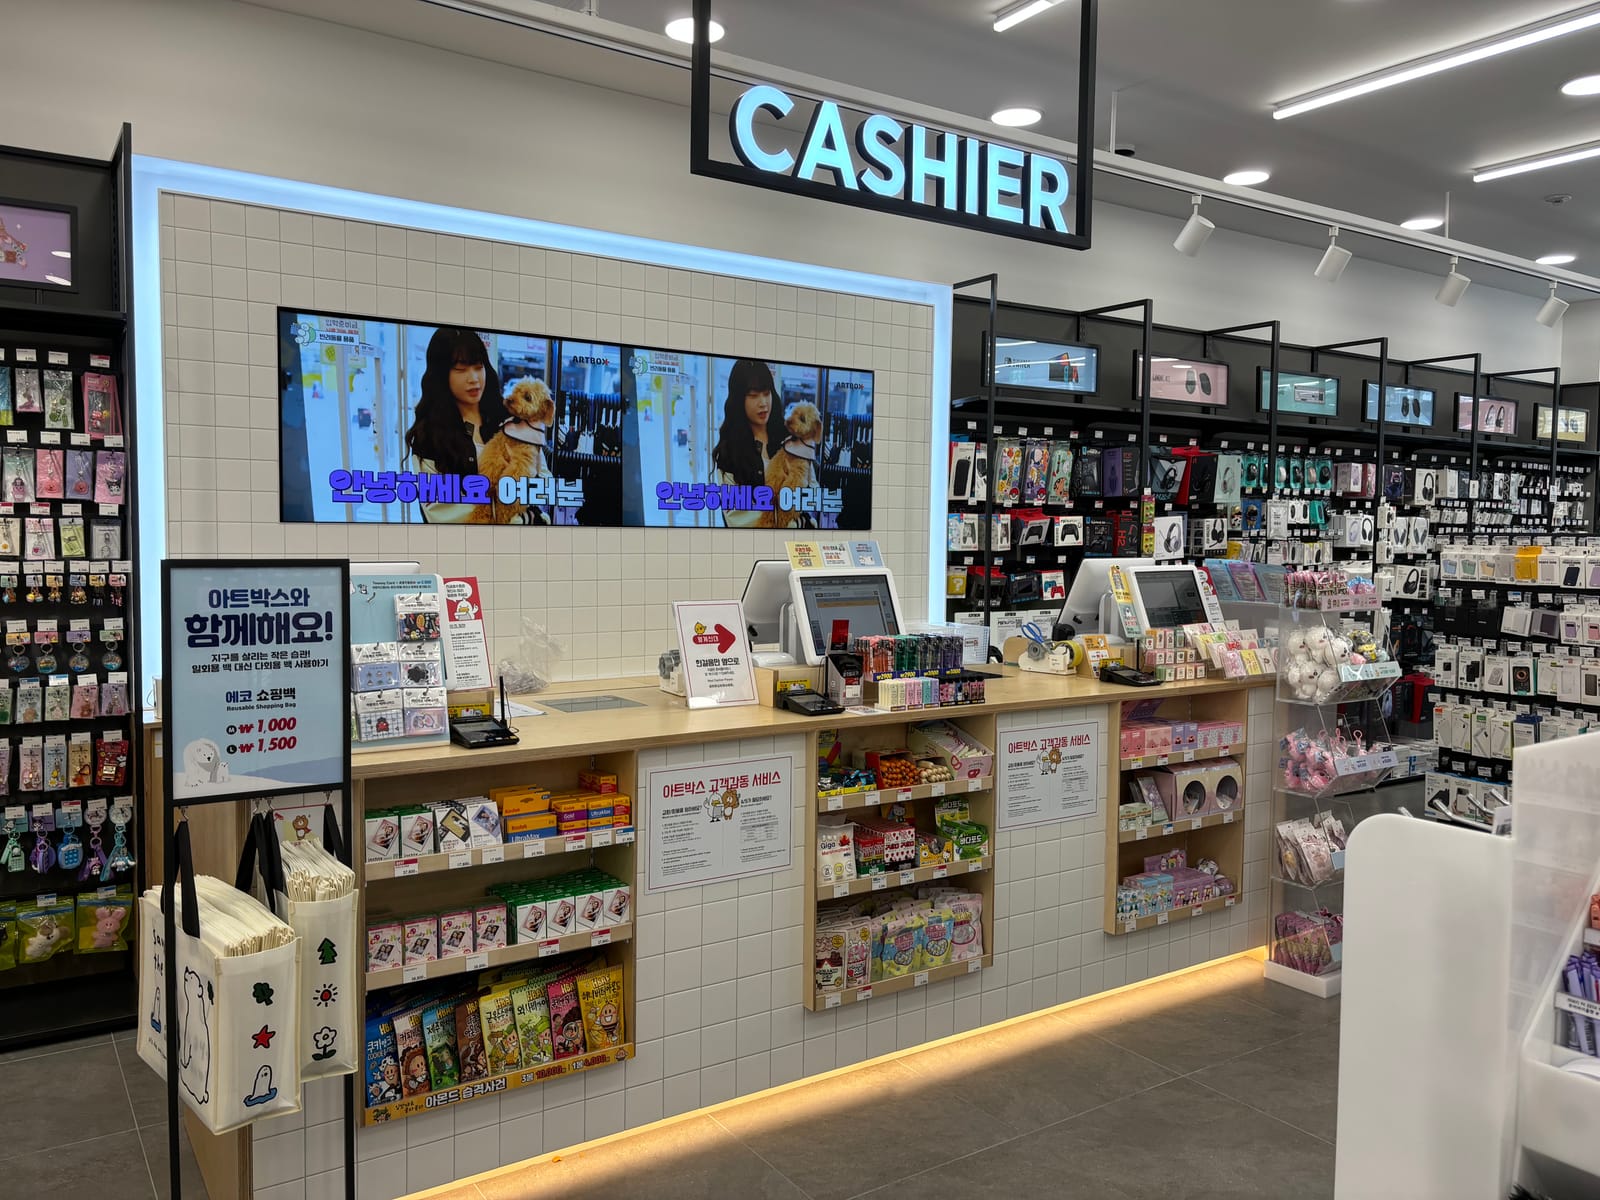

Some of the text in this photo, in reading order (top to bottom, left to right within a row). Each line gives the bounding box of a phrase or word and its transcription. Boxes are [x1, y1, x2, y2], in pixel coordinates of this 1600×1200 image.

[730, 84, 1070, 234] CASHIER
[572, 355, 609, 366] ARTBOX
[835, 381, 865, 390] ARTBOX
[329, 469, 585, 508] 안녕하세요 여러분
[656, 481, 844, 513] 안녕하세요 여러분
[208, 587, 310, 609] 아트박스와
[184, 611, 333, 648] 함께해요!
[192, 658, 329, 674] 일회용 백 대신 다회용 백 사용하기
[211, 650, 311, 663] 지구를 살리는 작은 습관!
[225, 687, 296, 703] 에코 쇼핑백
[256, 702, 284, 710] Shopping
[1008, 734, 1091, 754] 아트박스 고객감동 서비스
[663, 771, 781, 798] 아트박스 고객감동 서비스
[820, 841, 836, 850] Giga
[425, 1076, 507, 1108] 아몬드 습격사건
